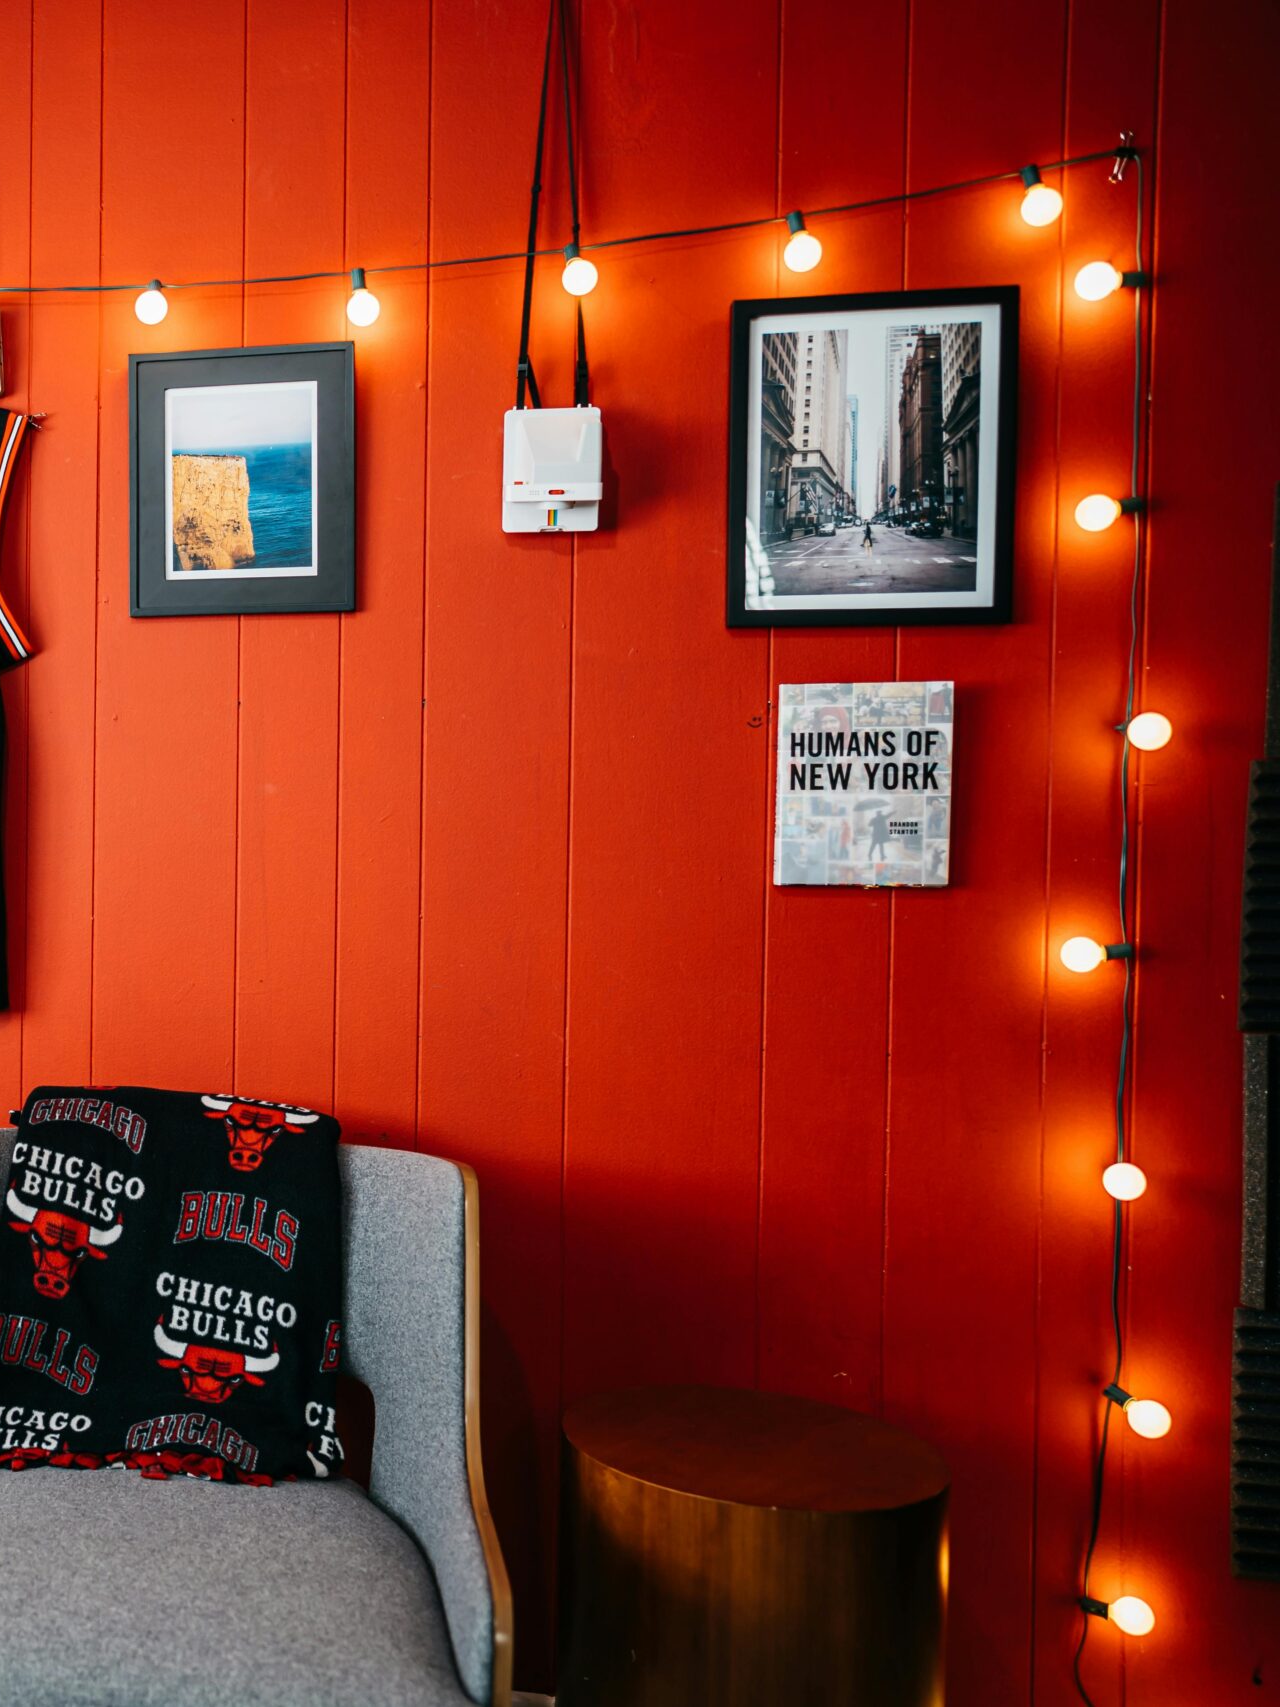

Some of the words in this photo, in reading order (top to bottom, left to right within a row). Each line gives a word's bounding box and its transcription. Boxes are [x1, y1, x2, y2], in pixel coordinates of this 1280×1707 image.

[790, 731, 896, 757] HUMANS
[907, 730, 939, 757] OF
[790, 763, 852, 791] NEW
[864, 762, 939, 790] YORK
[29, 1098, 147, 1154] CHICAGO
[12, 1142, 146, 1200] CHICAGO
[21, 1169, 117, 1222] BULLS
[173, 1191, 300, 1272] BULLS
[155, 1272, 297, 1328] CHICAGO
[169, 1304, 269, 1350] BULLS
